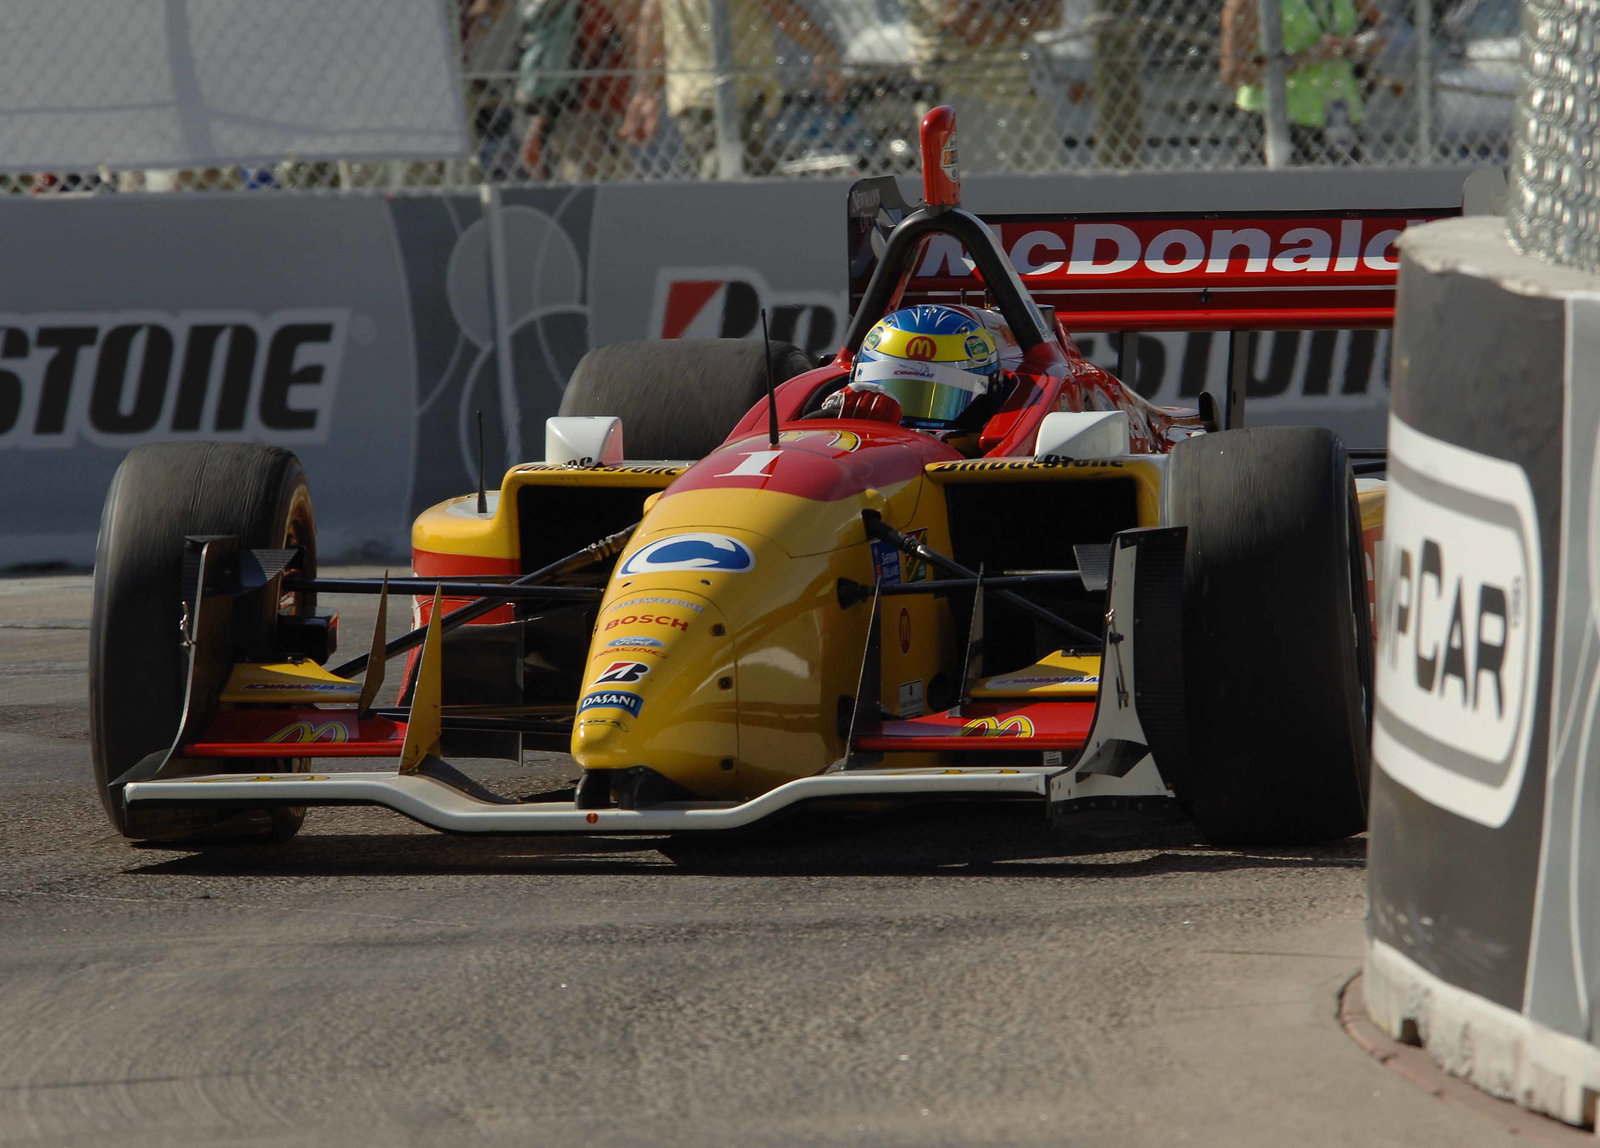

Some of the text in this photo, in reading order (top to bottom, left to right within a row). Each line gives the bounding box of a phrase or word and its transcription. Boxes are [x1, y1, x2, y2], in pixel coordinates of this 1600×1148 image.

[713, 450, 784, 478] 1
[604, 614, 689, 632] BOSCH
[582, 694, 637, 708] DASANI
